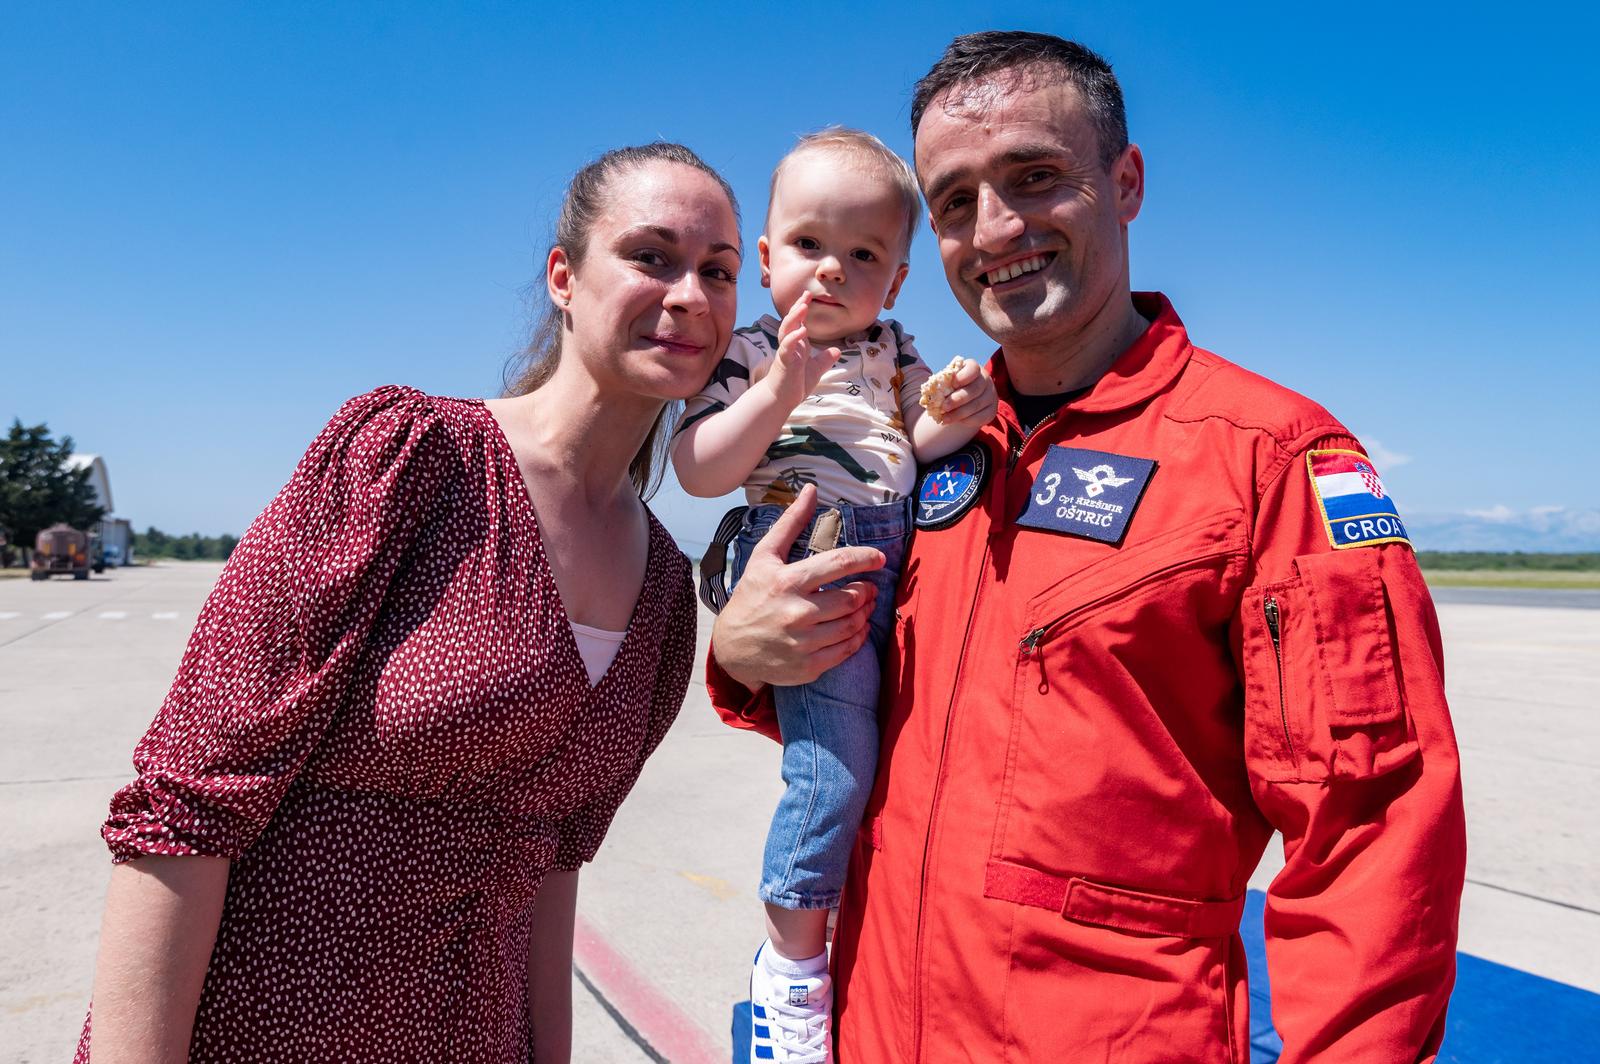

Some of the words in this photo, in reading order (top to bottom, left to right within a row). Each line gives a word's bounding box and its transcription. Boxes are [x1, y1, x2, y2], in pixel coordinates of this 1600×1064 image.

[1035, 472, 1061, 506] 3
[1059, 495, 1074, 504] Cpt
[1076, 497, 1123, 514] KREŠIMIR
[1056, 505, 1113, 527] OŠTRIĆ
